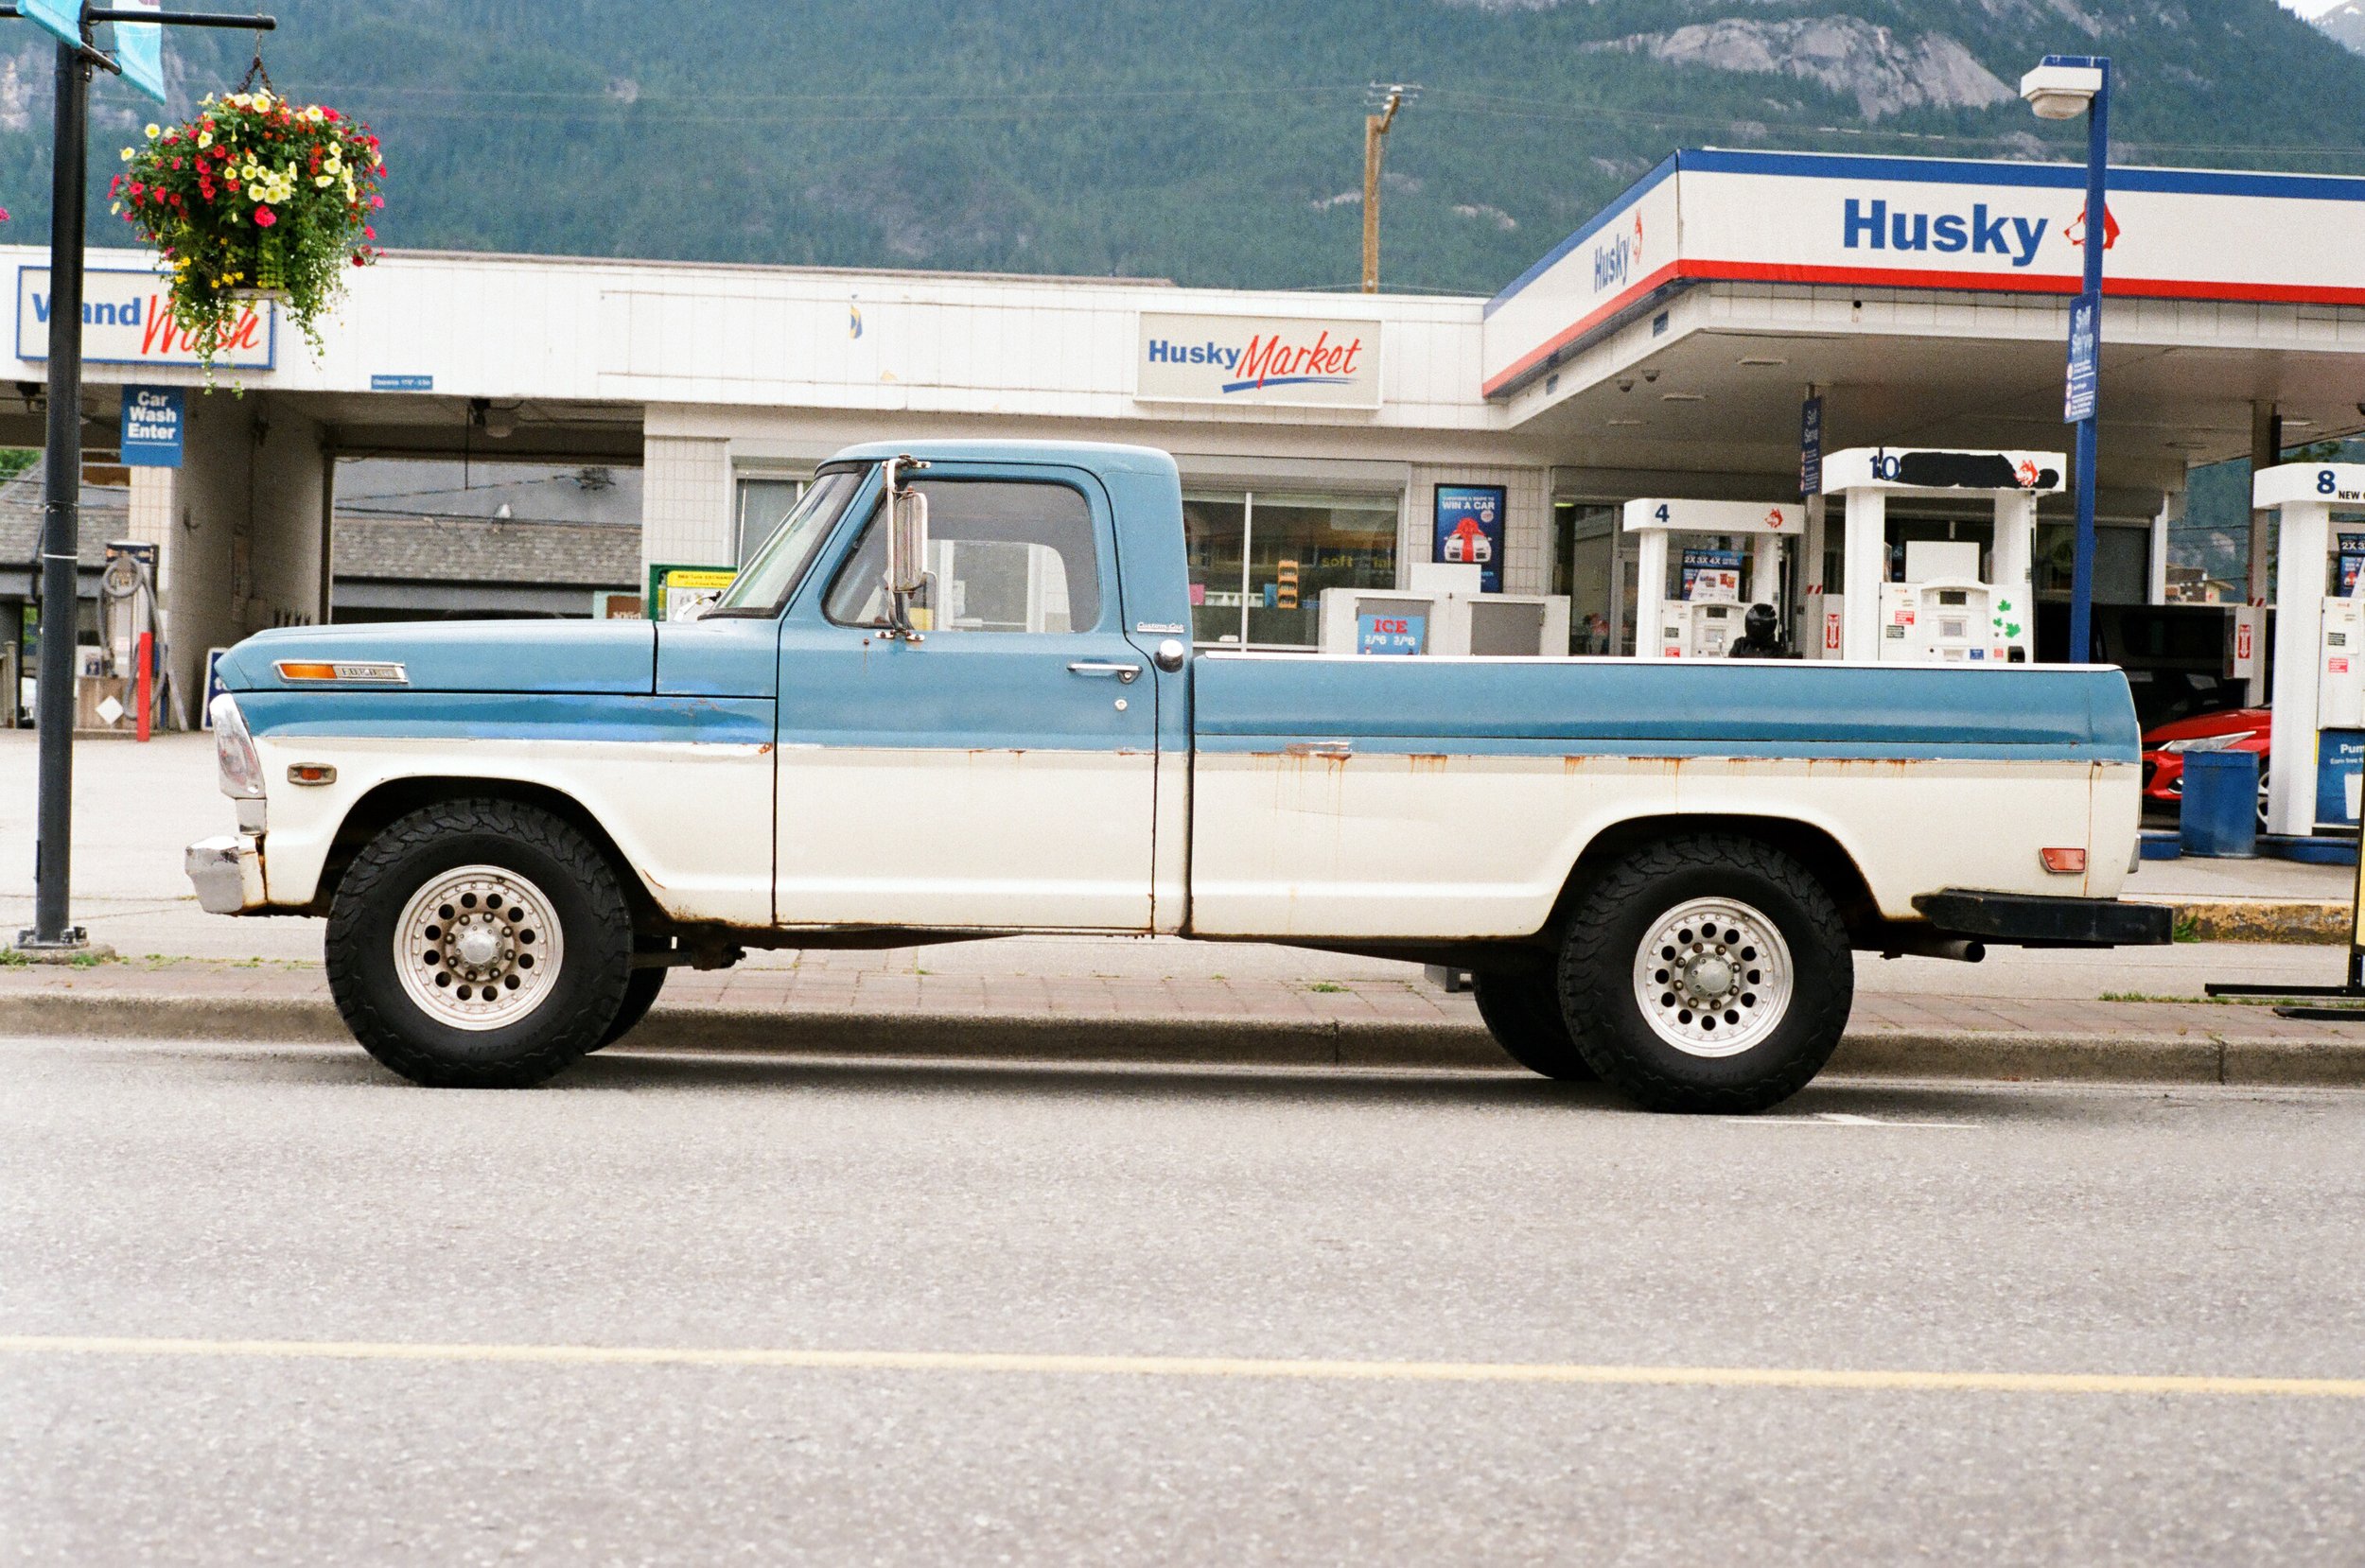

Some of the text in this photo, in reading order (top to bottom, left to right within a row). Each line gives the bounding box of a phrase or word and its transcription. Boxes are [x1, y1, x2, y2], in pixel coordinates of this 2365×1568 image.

[1844, 199, 2049, 267] Husky
[1594, 234, 1630, 293] Husky
[1148, 331, 1362, 390] Husky Market
[137, 391, 168, 407] Car
[129, 406, 177, 423] Wash
[128, 422, 177, 440] Enter
[1869, 455, 1901, 480] 10
[2317, 470, 2336, 494] 8
[2339, 491, 2360, 499] NEW
[1442, 501, 1495, 510] WIN A CAR
[1655, 504, 1670, 523] 4
[1684, 555, 1696, 564] 2X
[1374, 618, 1408, 634] ICE
